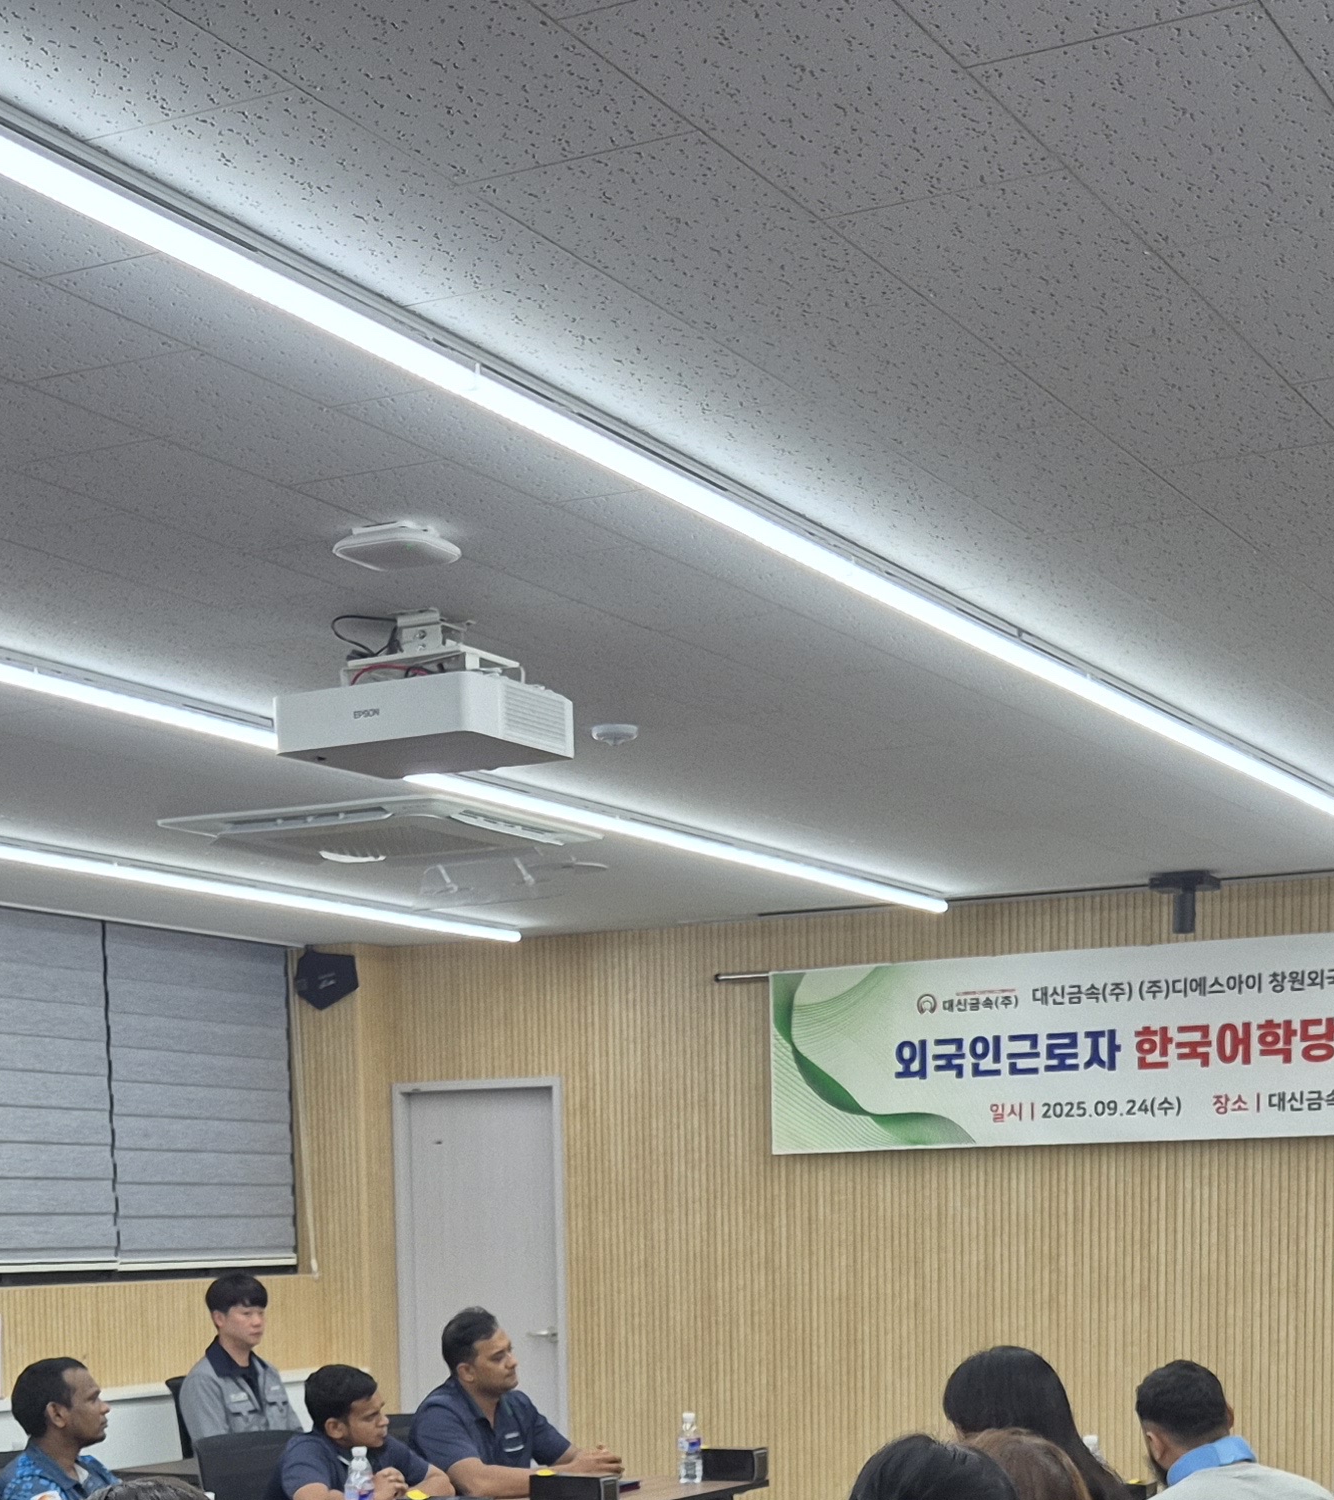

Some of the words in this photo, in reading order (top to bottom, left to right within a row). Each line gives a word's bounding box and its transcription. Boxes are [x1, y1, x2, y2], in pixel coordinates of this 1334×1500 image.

[353, 709, 380, 719] EPSON
[1031, 980, 1134, 1006] 대신금속(주)
[1138, 971, 1264, 1001] (주)디에스아이
[942, 994, 1019, 1013] 대신금속(주)
[893, 1028, 1122, 1080] 외국인근로자
[989, 1101, 1023, 1123] 일시
[1041, 1096, 1183, 1121] 2025.09.24(수)
[1212, 1093, 1249, 1115] 장소
